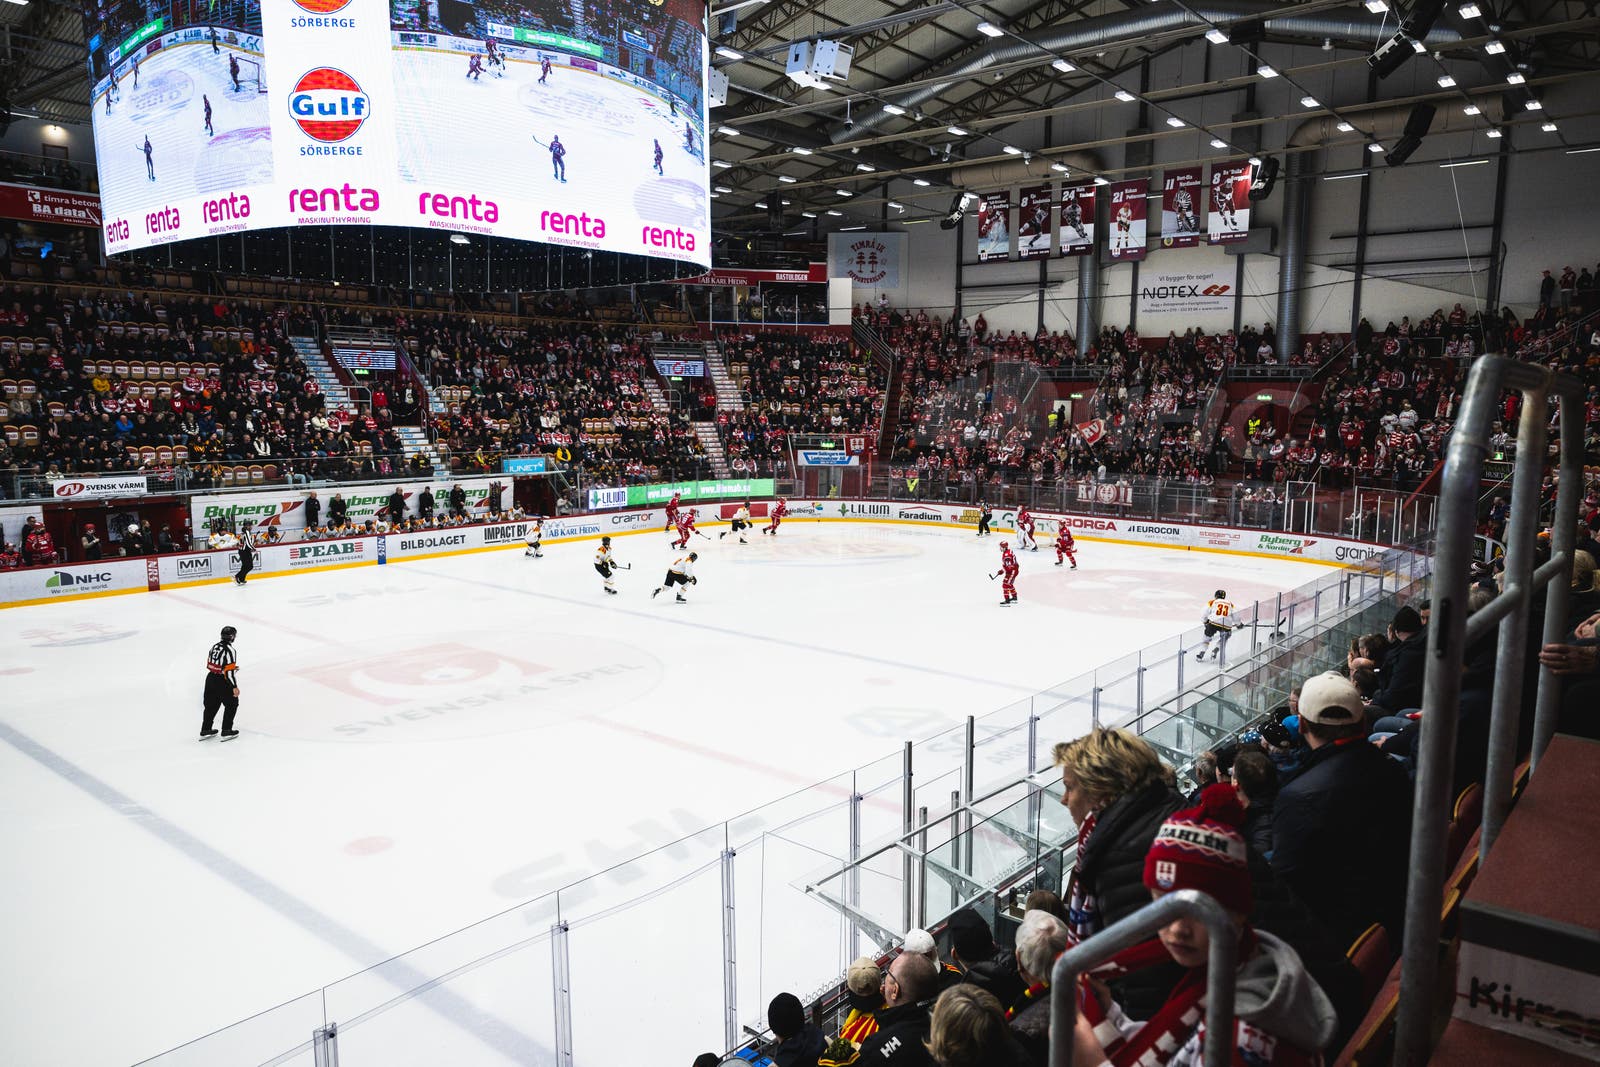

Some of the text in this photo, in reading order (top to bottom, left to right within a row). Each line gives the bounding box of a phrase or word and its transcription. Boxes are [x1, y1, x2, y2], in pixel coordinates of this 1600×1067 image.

[291, 16, 356, 28] SÖRBERGE
[292, 94, 366, 116] Gulf
[299, 144, 363, 156] SÖRBERGE
[1165, 179, 1174, 190] 11
[1212, 172, 1221, 184] 8
[289, 182, 380, 212] renta
[1021, 197, 1029, 207] 8
[1062, 190, 1075, 201] 24
[1112, 191, 1124, 203] 21
[32, 203, 52, 214] BA
[54, 207, 87, 218] data
[202, 191, 251, 224] renta
[418, 192, 499, 223] renta
[145, 205, 180, 235] renta
[297, 216, 371, 224] MASKINUTHYRNING
[429, 220, 493, 234] MASKINUTHYRNING
[541, 210, 606, 239] renta
[106, 217, 130, 244] renta
[642, 225, 696, 252] renta
[1142, 285, 1199, 300] NOTEX
[86, 481, 145, 491] SVENSK VÄRME
[602, 490, 626, 504] LILIUM
[203, 504, 277, 520] Byberg
[851, 504, 890, 514] LILIUM
[898, 511, 942, 521] Faradium
[484, 523, 528, 540] IMPACT BY
[550, 525, 601, 537] AB KARL HEDIN
[1064, 518, 1117, 532] BORGA
[1137, 525, 1180, 535] EUROCON
[400, 534, 466, 551] BILBOLAGET
[1259, 534, 1302, 547] Byberg
[298, 542, 355, 558] PEAB
[179, 558, 209, 569] MM
[75, 571, 112, 585] NHC
[1215, 603, 1228, 617] 33
[212, 649, 220, 660] 27
[333, 683, 550, 737] SVENSKA
